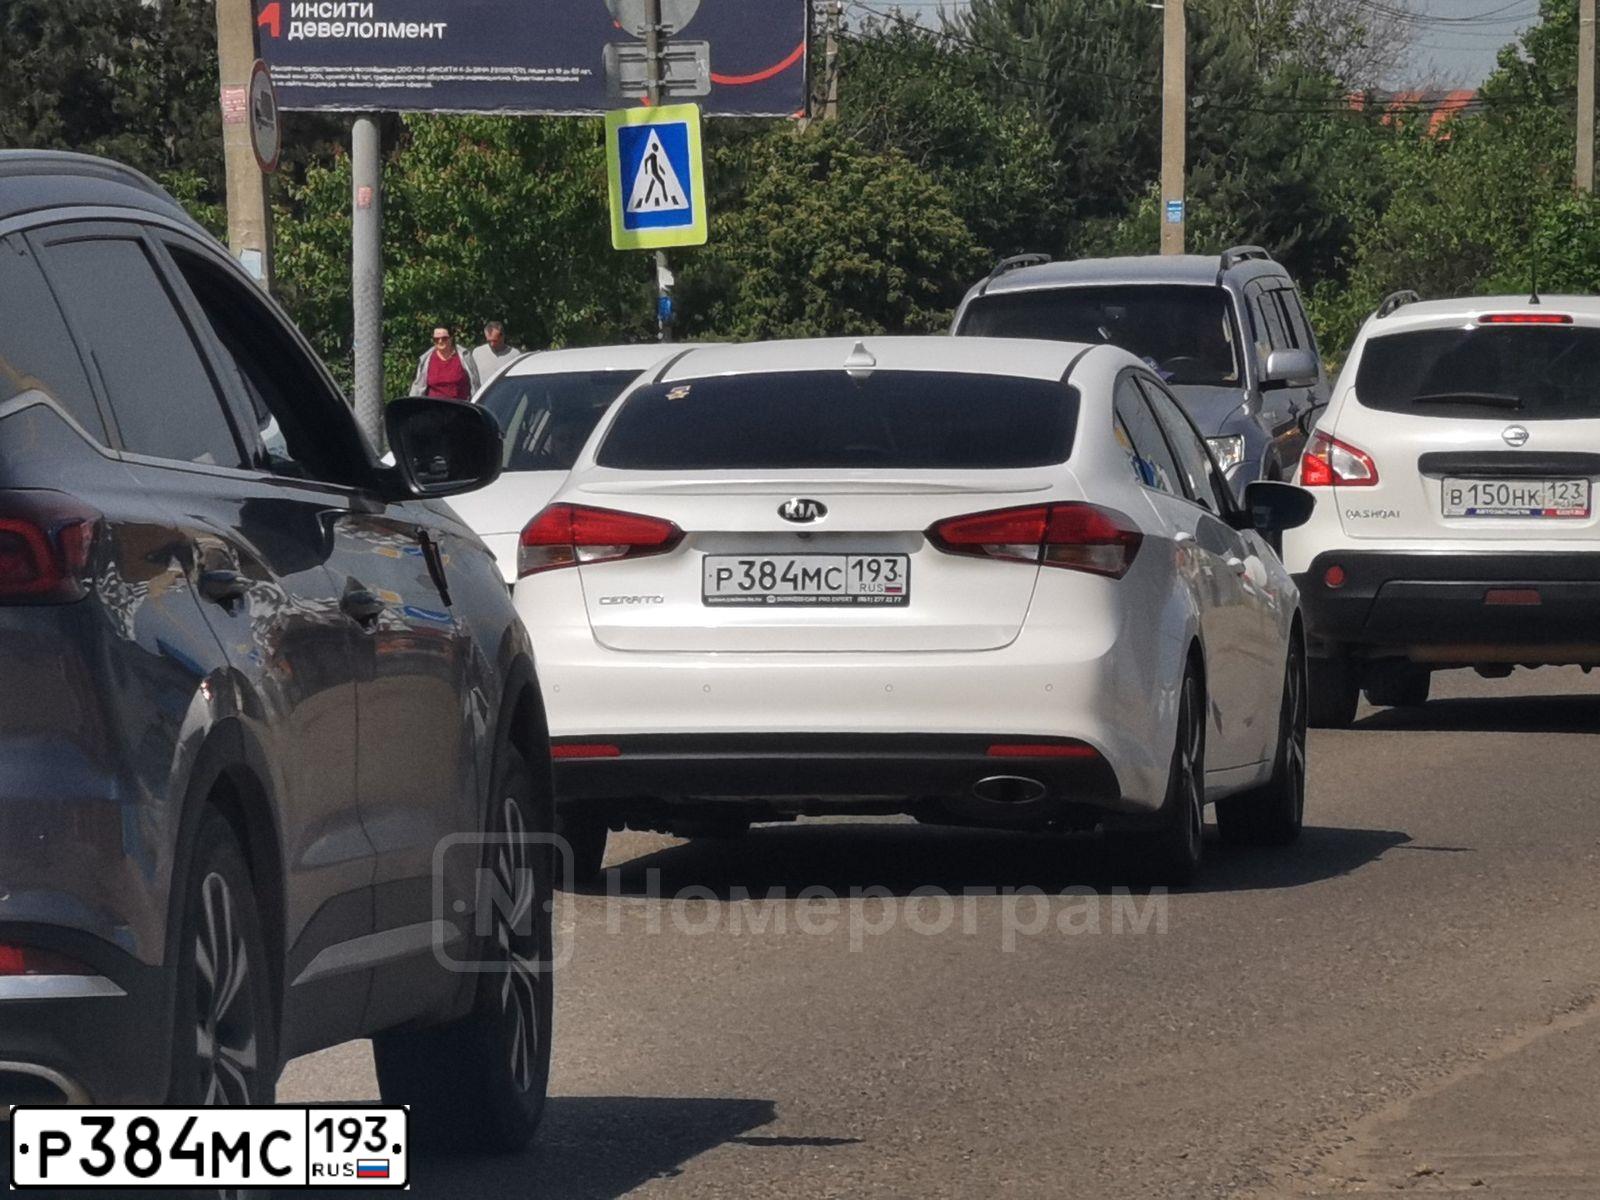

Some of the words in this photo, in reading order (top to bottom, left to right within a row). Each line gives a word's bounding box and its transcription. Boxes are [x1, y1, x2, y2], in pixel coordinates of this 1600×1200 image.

[1450, 484, 1540, 506] В150НК
[1547, 482, 1582, 500] 123
[785, 503, 818, 518] KIA
[716, 560, 842, 591] Р384МС
[851, 559, 897, 582] 193
[859, 583, 883, 593] RUS
